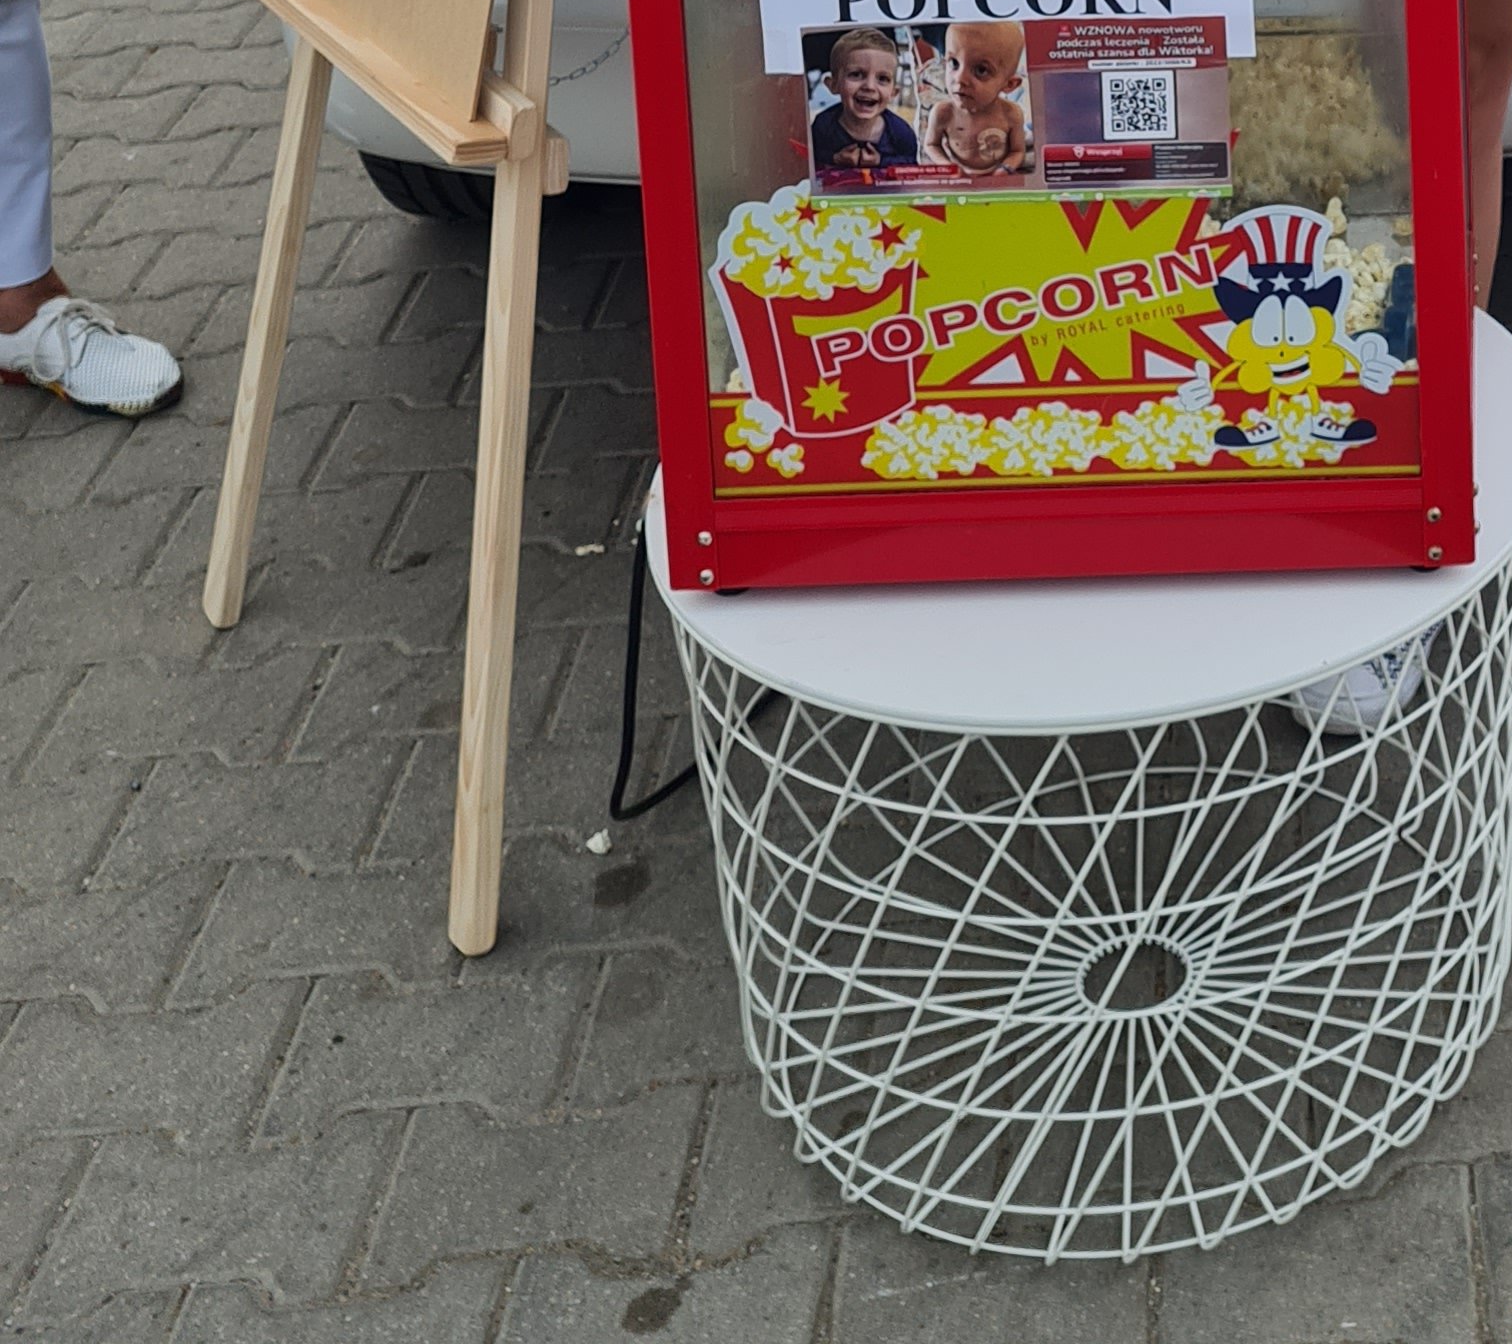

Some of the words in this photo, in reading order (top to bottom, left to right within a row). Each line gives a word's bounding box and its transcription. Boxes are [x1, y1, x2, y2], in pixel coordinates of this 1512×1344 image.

[1074, 25, 1135, 36] WZNOWA
[1138, 24, 1203, 35] nowotworu
[1056, 37, 1101, 48] podczas
[1104, 36, 1150, 47] leczenia
[1163, 35, 1205, 46] Została
[1049, 49, 1095, 59] ostatnia
[1097, 49, 1135, 58] szansa
[1137, 48, 1156, 57] dla
[1158, 45, 1214, 56] Wiktorka!
[812, 244, 1219, 377] POPCORN
[1031, 333, 1049, 348] by
[1056, 321, 1108, 341] ROYAL
[1116, 302, 1186, 327] catering
